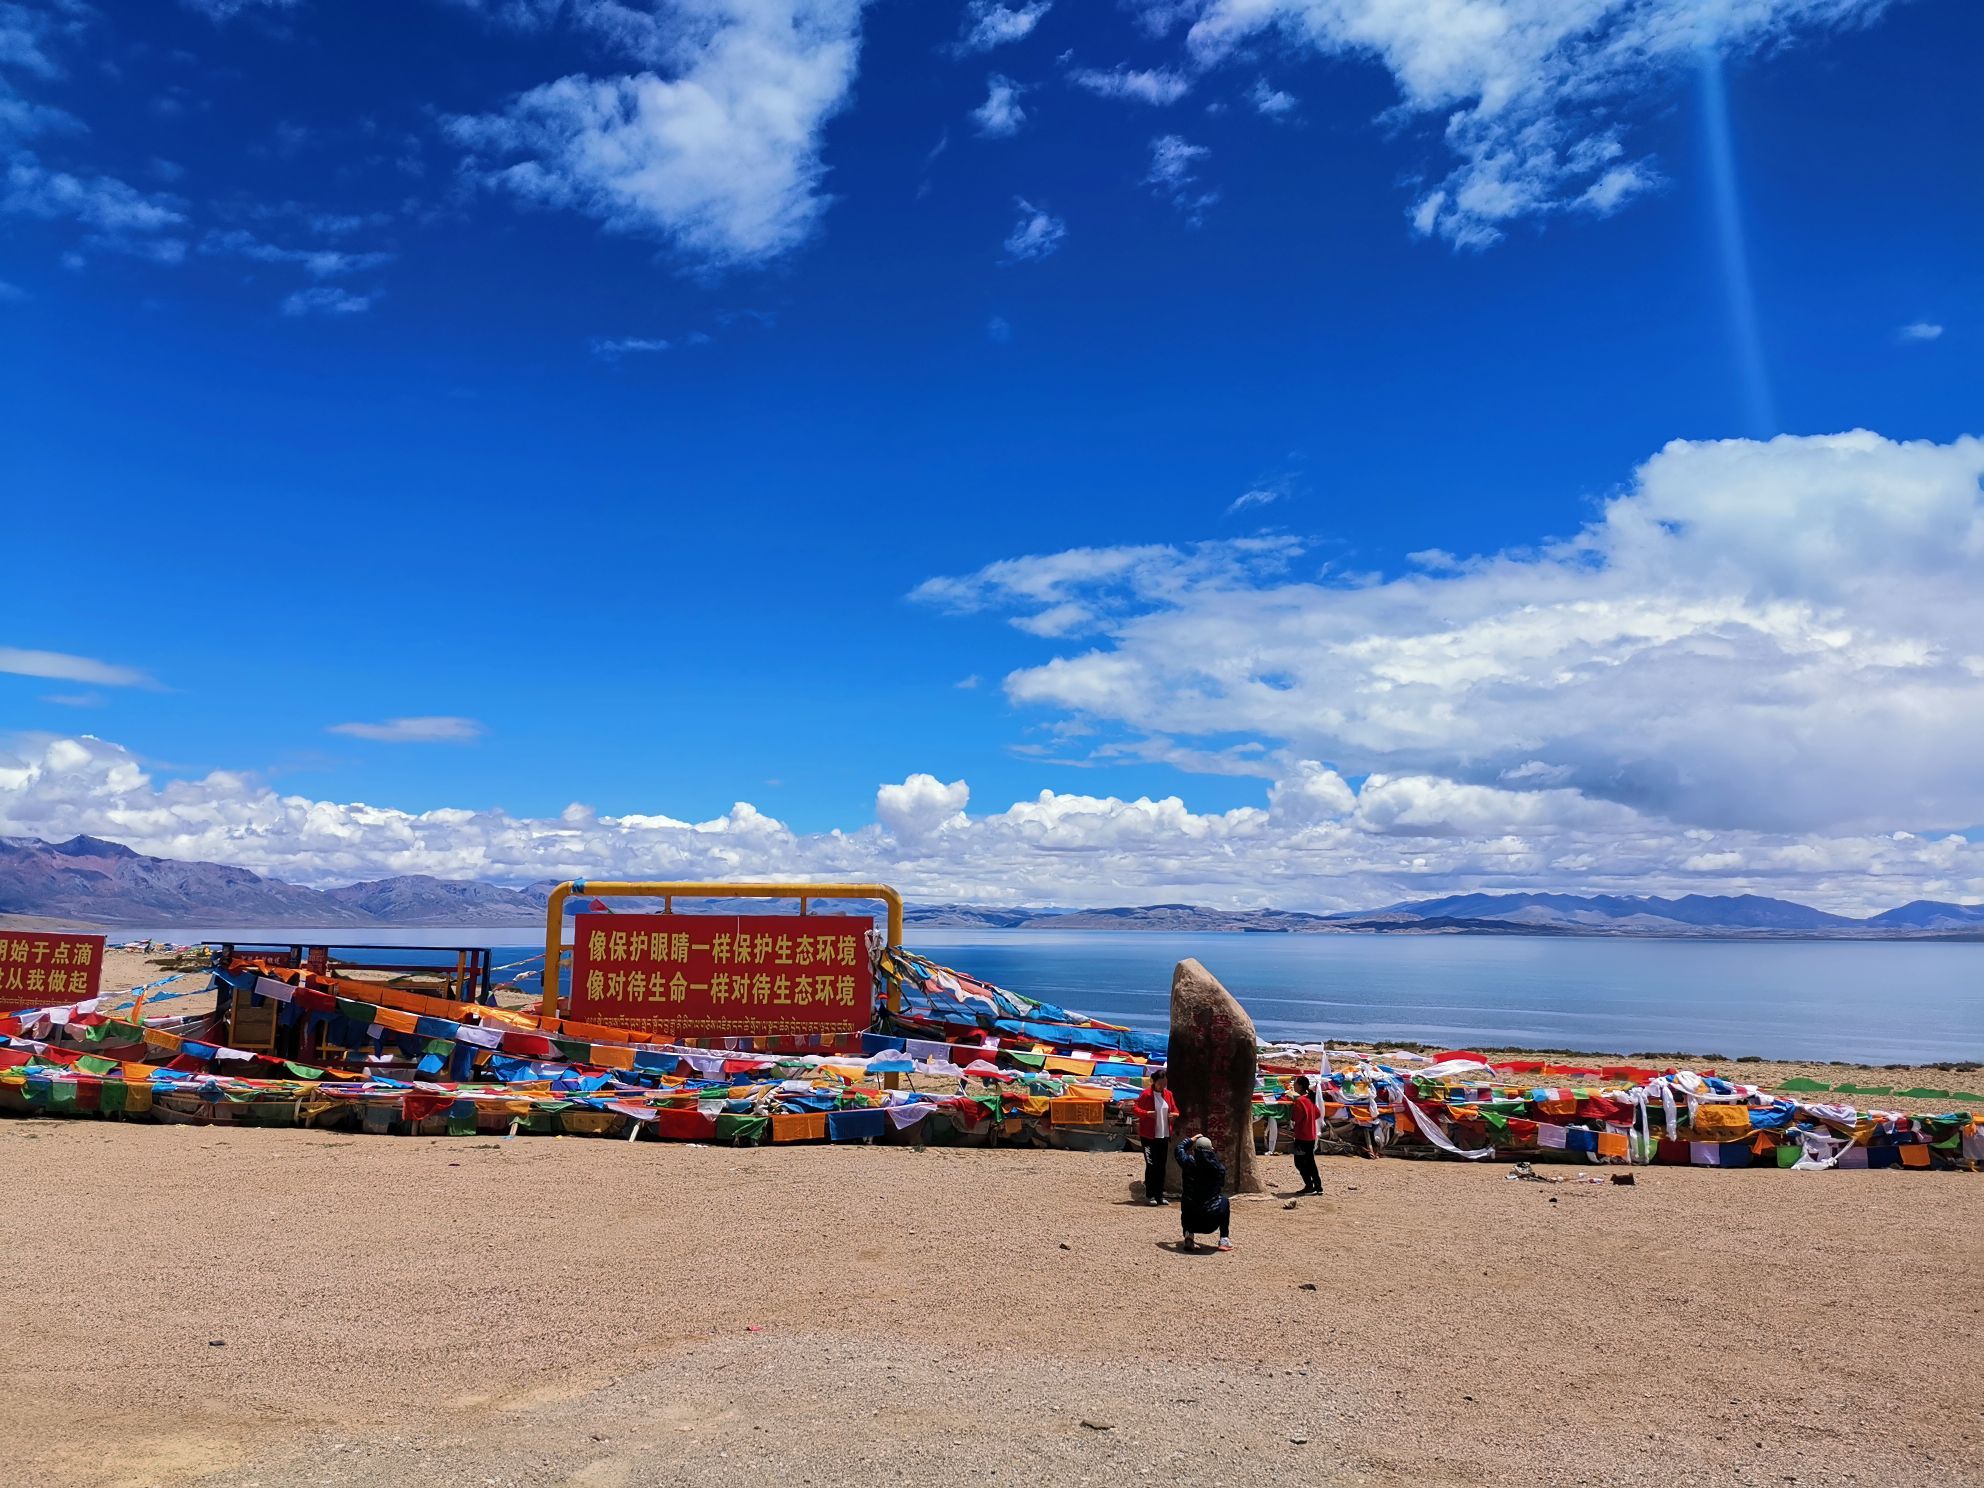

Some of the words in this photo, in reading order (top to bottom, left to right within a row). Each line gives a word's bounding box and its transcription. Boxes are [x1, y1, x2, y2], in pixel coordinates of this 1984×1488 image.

[588, 930, 857, 966] 像保护眼睛一样保护生态环境
[0, 967, 87, 993] 从我做起
[586, 969, 855, 1006] 像对待生命一样对待生态环境
